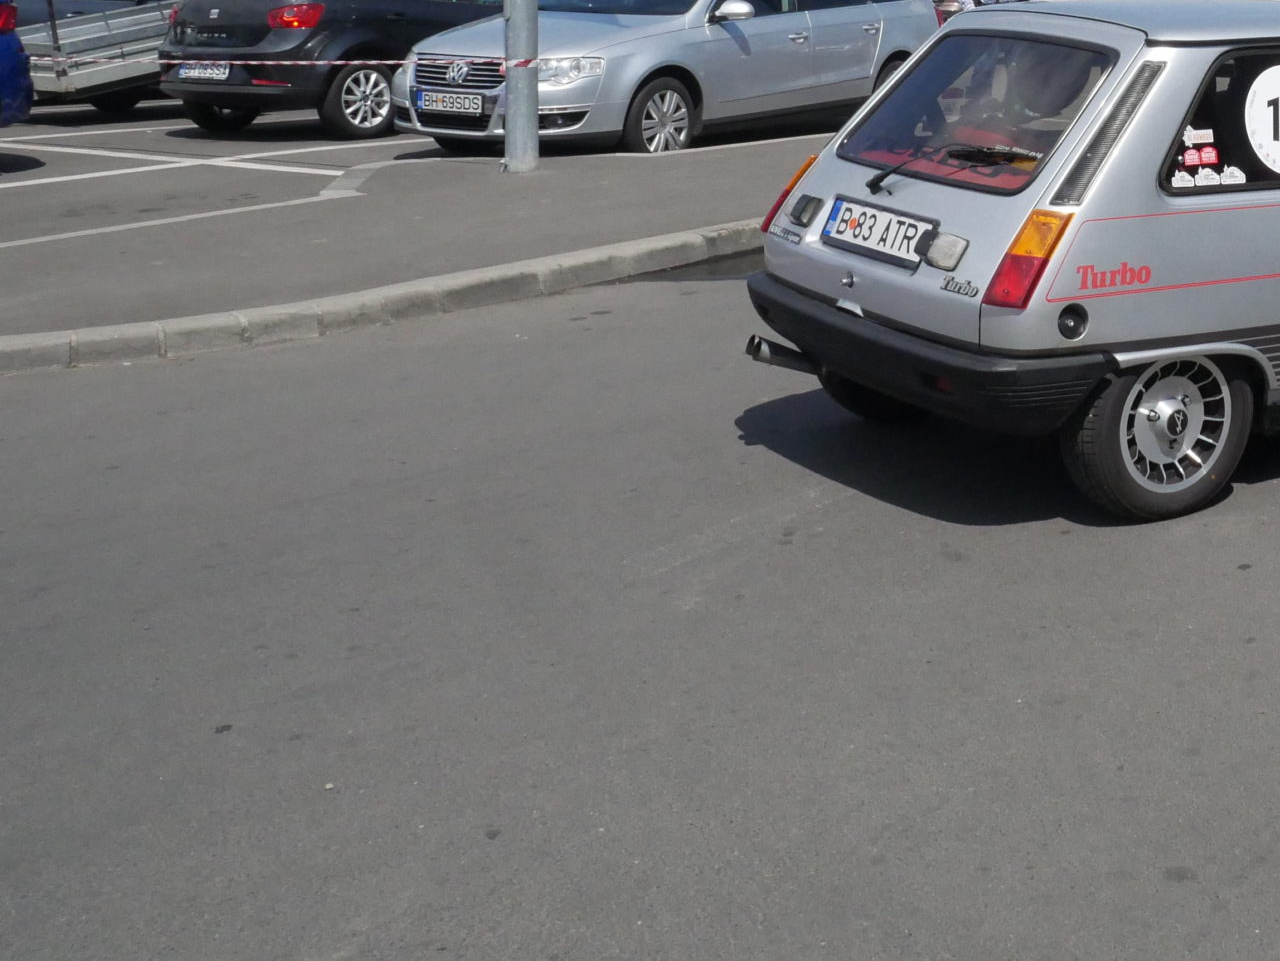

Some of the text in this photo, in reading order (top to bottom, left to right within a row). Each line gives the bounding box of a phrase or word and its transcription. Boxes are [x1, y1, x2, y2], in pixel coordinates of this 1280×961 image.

[423, 94, 439, 109] BH
[836, 207, 853, 235] B
[853, 211, 877, 242] 83
[877, 218, 918, 254] ATR
[940, 274, 979, 297] Turbo
[1076, 261, 1152, 290] Turbo
